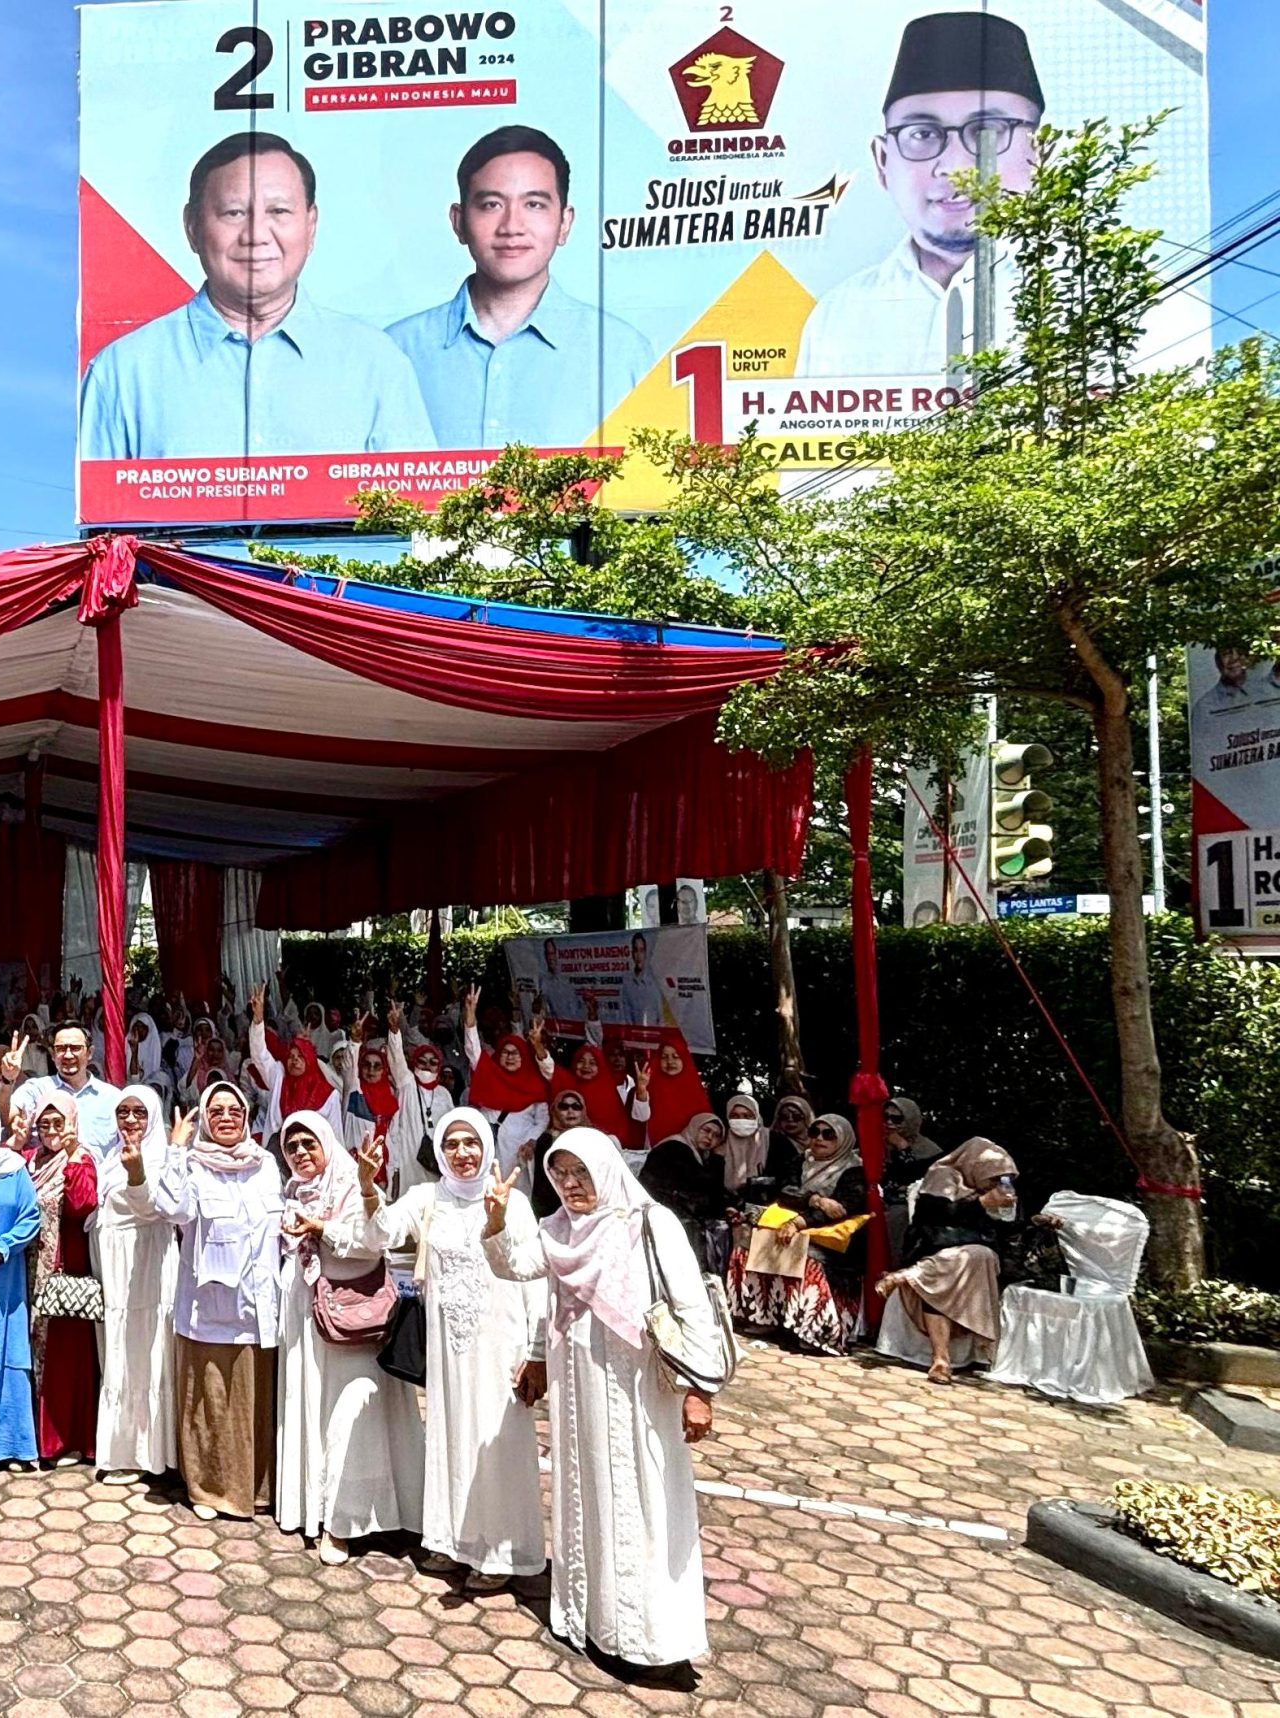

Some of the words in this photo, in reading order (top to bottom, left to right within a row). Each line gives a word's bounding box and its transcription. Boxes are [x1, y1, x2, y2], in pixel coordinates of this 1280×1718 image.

[720, 6, 734, 22] 2
[304, 11, 516, 47] PRABOWO
[214, 26, 274, 111] 2
[304, 46, 467, 81] GIBRAN
[479, 53, 516, 65] 2024
[312, 92, 378, 105] BERSAMA
[384, 89, 465, 102] INDONESIA
[471, 87, 509, 98] MAJU
[668, 135, 786, 155] GERINDRA
[713, 152, 760, 161] INDONESIA
[601, 210, 734, 250] SUMATERA
[743, 203, 830, 240] BARAT
[732, 348, 787, 360] NOMOR
[732, 361, 770, 372] URUT
[742, 391, 776, 415] H.
[784, 388, 903, 415] ANDRE
[779, 418, 843, 429] ANGGOTA
[845, 418, 869, 428] DPR
[872, 418, 884, 428] RI
[754, 441, 857, 462] CALEG
[116, 467, 211, 484] PRABOWO
[215, 465, 309, 482] SUBIANTO
[328, 462, 400, 480] GIBRAN
[139, 485, 193, 499] CALON
[196, 483, 267, 498] PRESIDEN
[271, 483, 285, 496] RI
[357, 478, 412, 493] CALON
[416, 477, 464, 491] WAKIL
[1207, 839, 1245, 927] 1
[1010, 899, 1028, 909] POS
[1029, 897, 1063, 908] LANTAS
